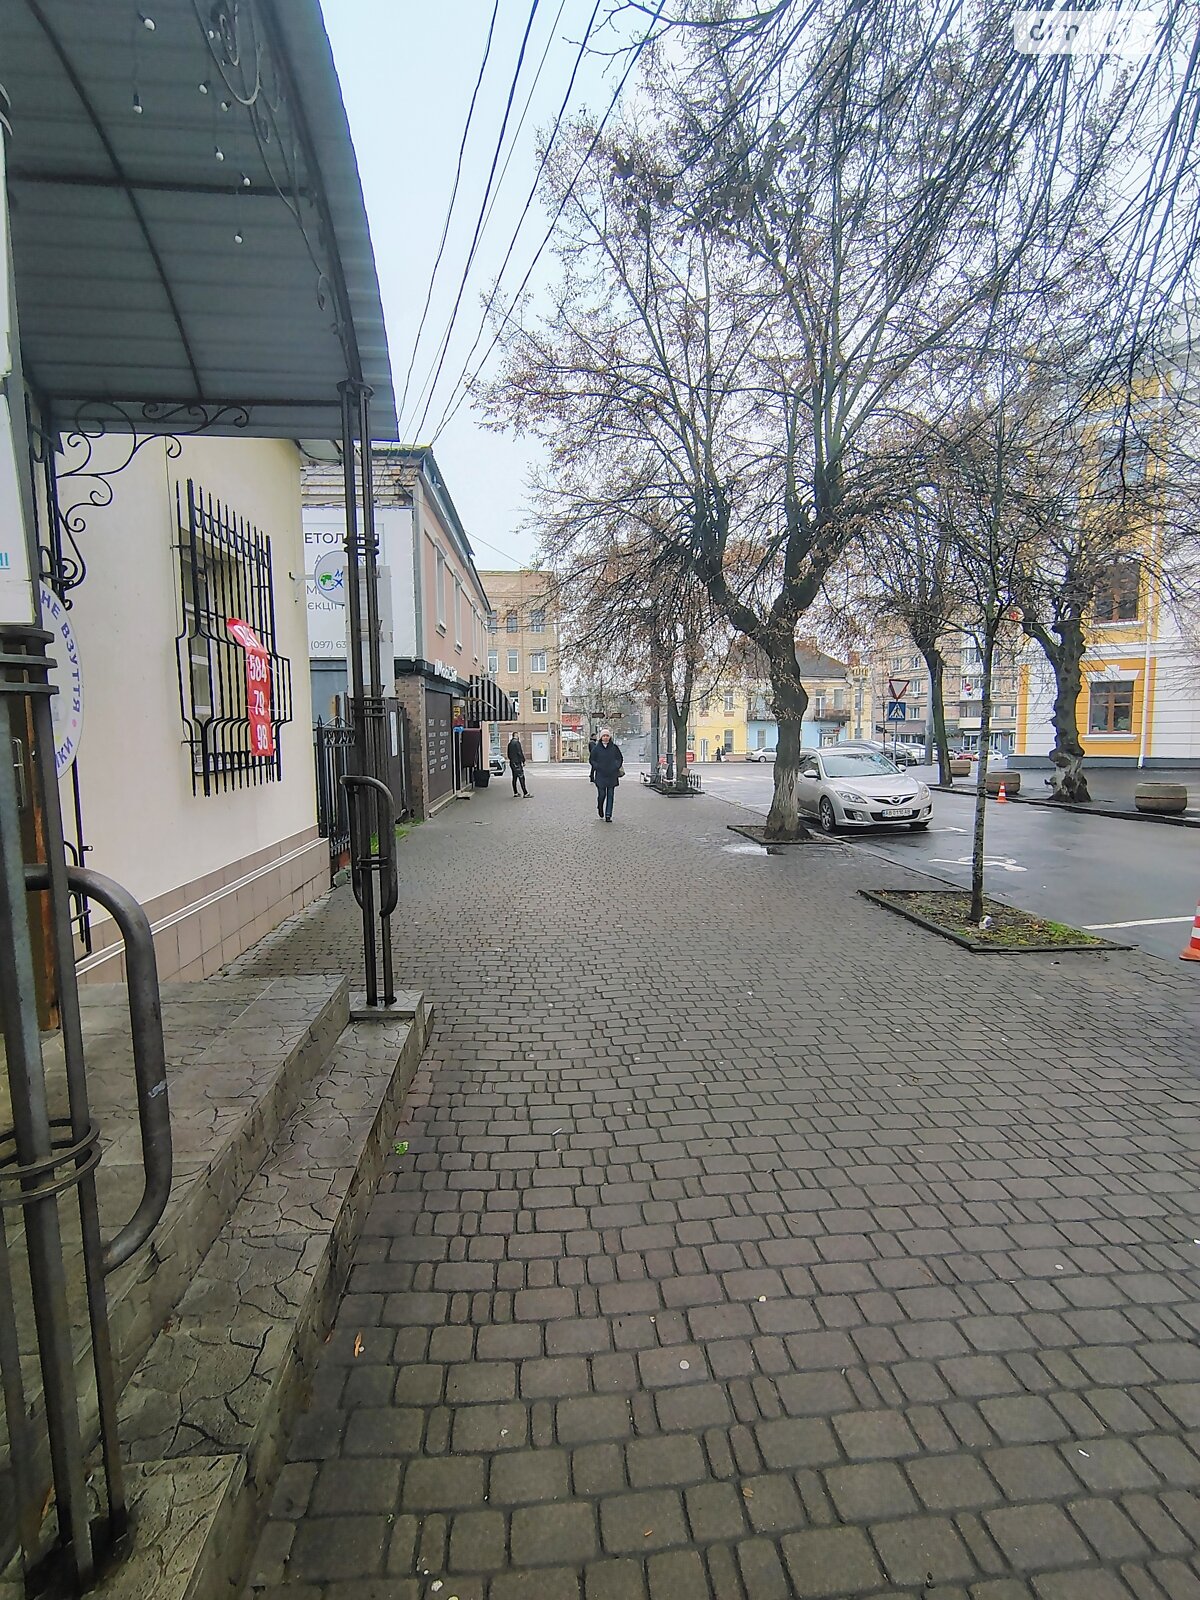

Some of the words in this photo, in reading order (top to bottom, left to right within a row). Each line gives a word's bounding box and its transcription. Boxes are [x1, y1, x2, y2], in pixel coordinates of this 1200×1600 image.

[311, 640, 334, 650] (097)
[335, 640, 347, 649] 63
[60, 621, 82, 714] ВЗУТТЯ
[249, 655, 267, 682] 584
[253, 690, 265, 716] 79
[256, 724, 268, 750] 98
